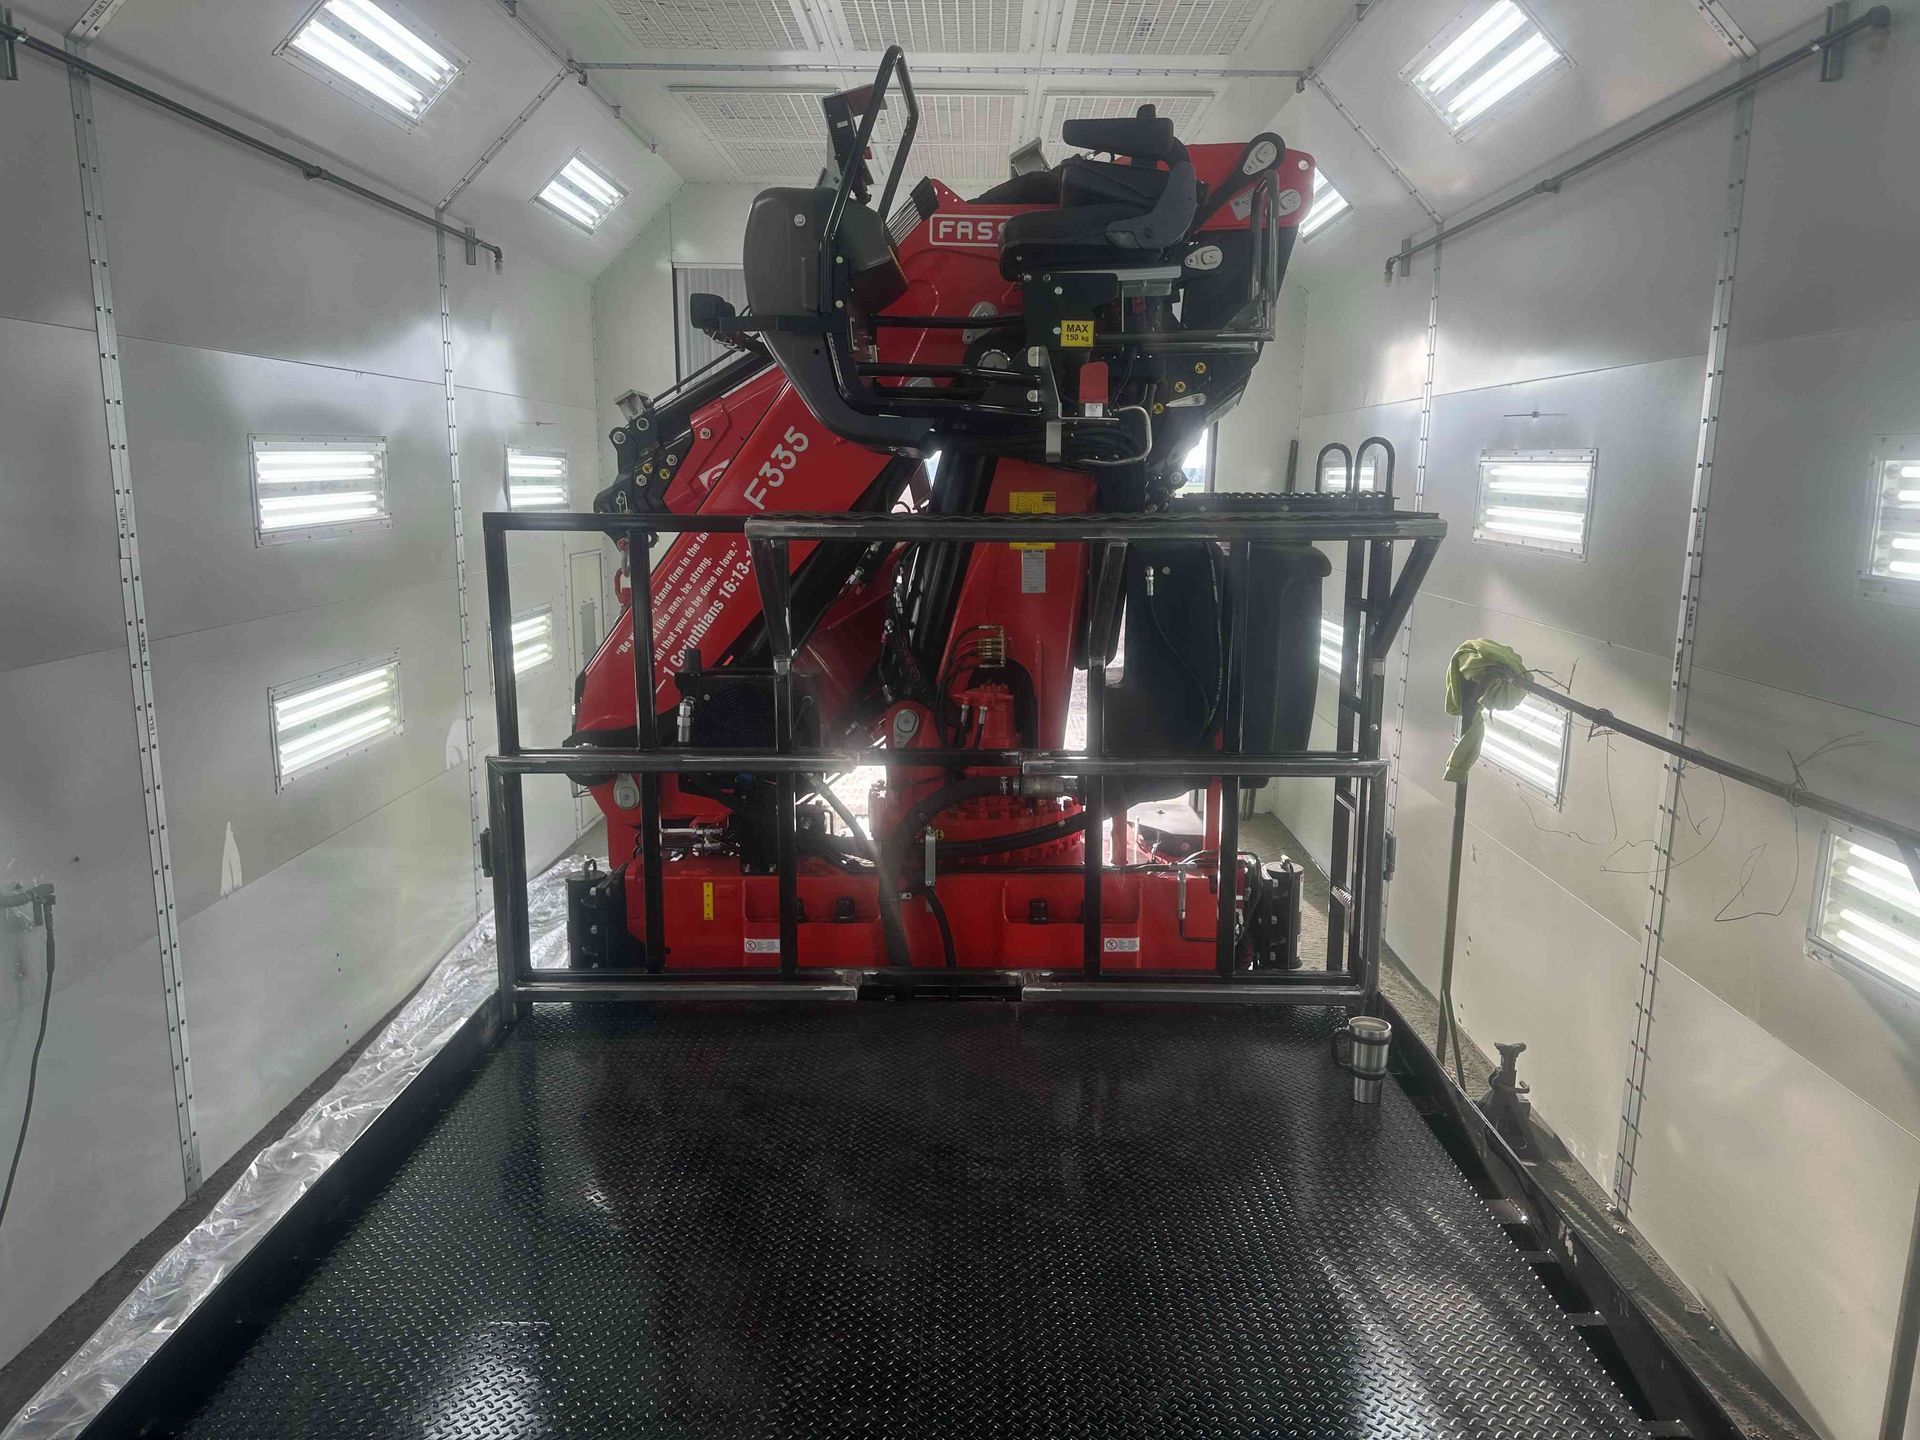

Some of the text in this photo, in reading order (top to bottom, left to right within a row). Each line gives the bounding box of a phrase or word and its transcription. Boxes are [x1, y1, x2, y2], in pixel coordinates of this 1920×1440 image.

[1066, 324, 1089, 333] MAX
[743, 425, 809, 510] F335
[654, 582, 673, 606] stand
[668, 565, 686, 584] firm
[679, 557, 691, 568] in
[687, 542, 700, 559] the
[656, 613, 671, 630] like
[668, 593, 686, 616] men,
[680, 581, 693, 594] be
[690, 556, 712, 583] strong.
[655, 647, 666, 661] all
[661, 631, 677, 649] that
[675, 617, 688, 634] you
[685, 604, 696, 617] do
[693, 592, 704, 607] be
[700, 576, 718, 597] done
[715, 566, 724, 577] in
[663, 666, 675, 677] 1
[670, 599, 725, 667] Corinthians
